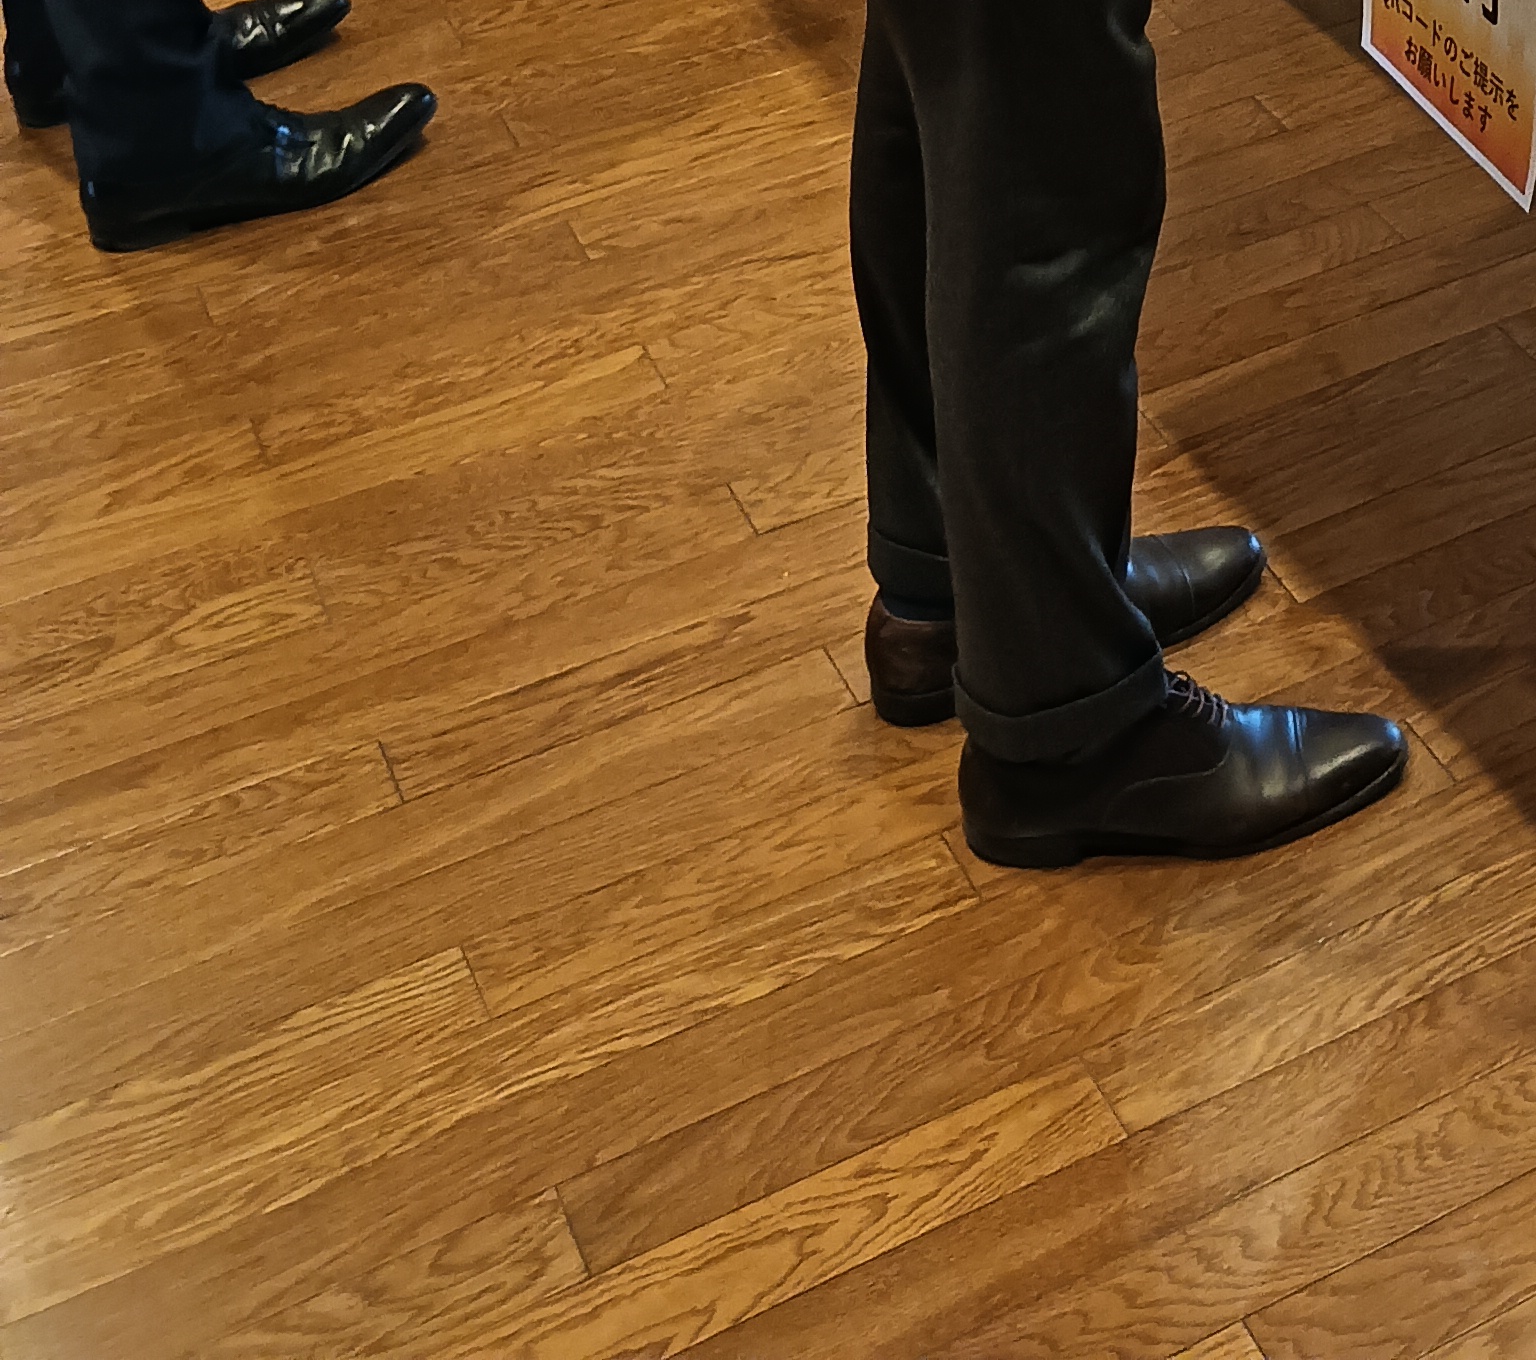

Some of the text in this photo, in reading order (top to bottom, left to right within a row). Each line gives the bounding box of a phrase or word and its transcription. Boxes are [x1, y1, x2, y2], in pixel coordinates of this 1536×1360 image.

[1404, 35, 1493, 134] お願いします
